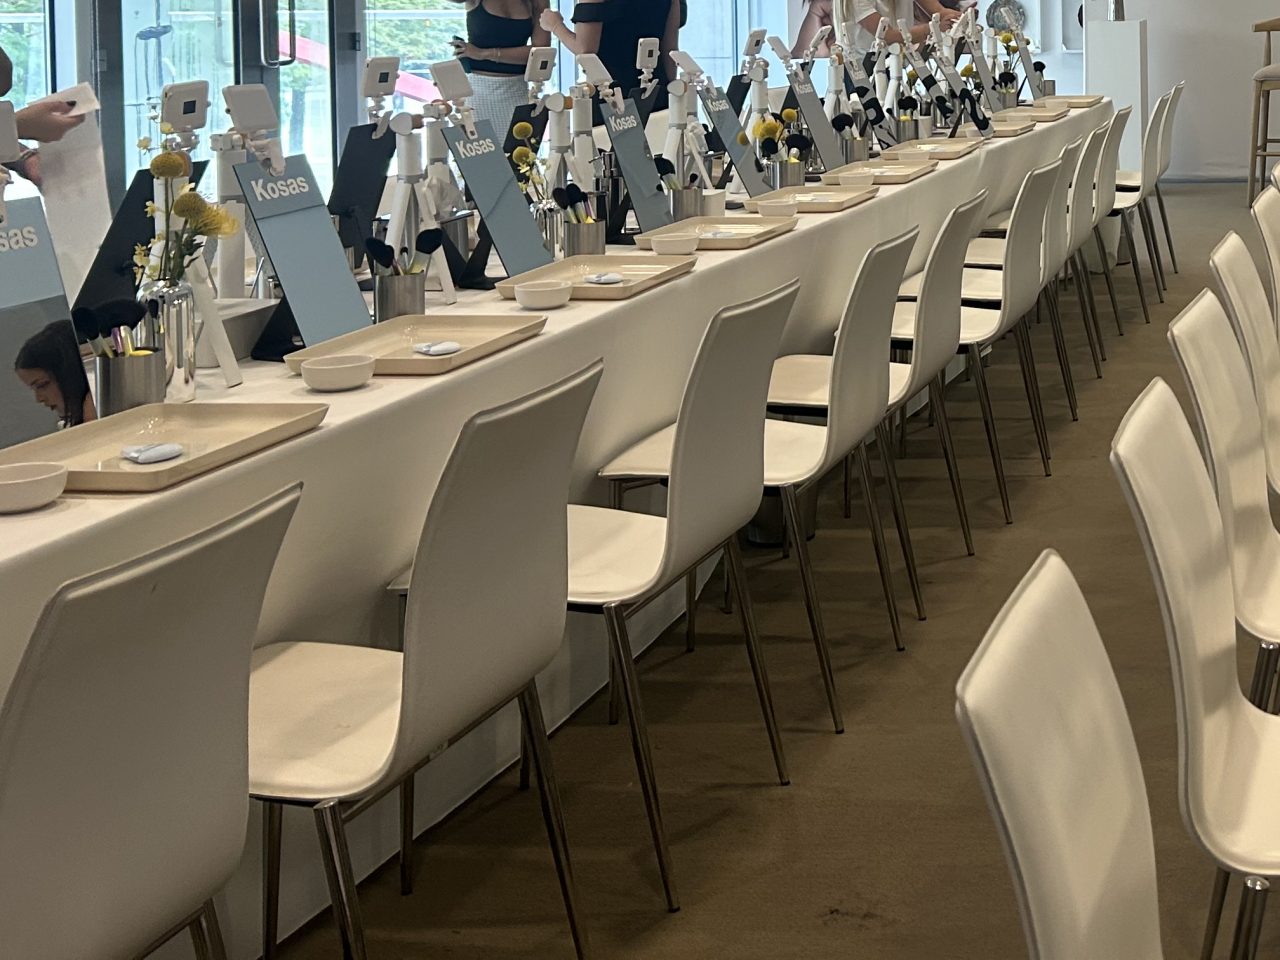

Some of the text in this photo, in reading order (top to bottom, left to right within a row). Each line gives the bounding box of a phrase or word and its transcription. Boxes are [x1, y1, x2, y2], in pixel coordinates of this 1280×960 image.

[705, 99, 730, 113] Kosas
[608, 114, 638, 132] Kosas
[455, 138, 496, 159] Kosas
[250, 176, 309, 202] Kosas
[0, 226, 38, 252] sas
